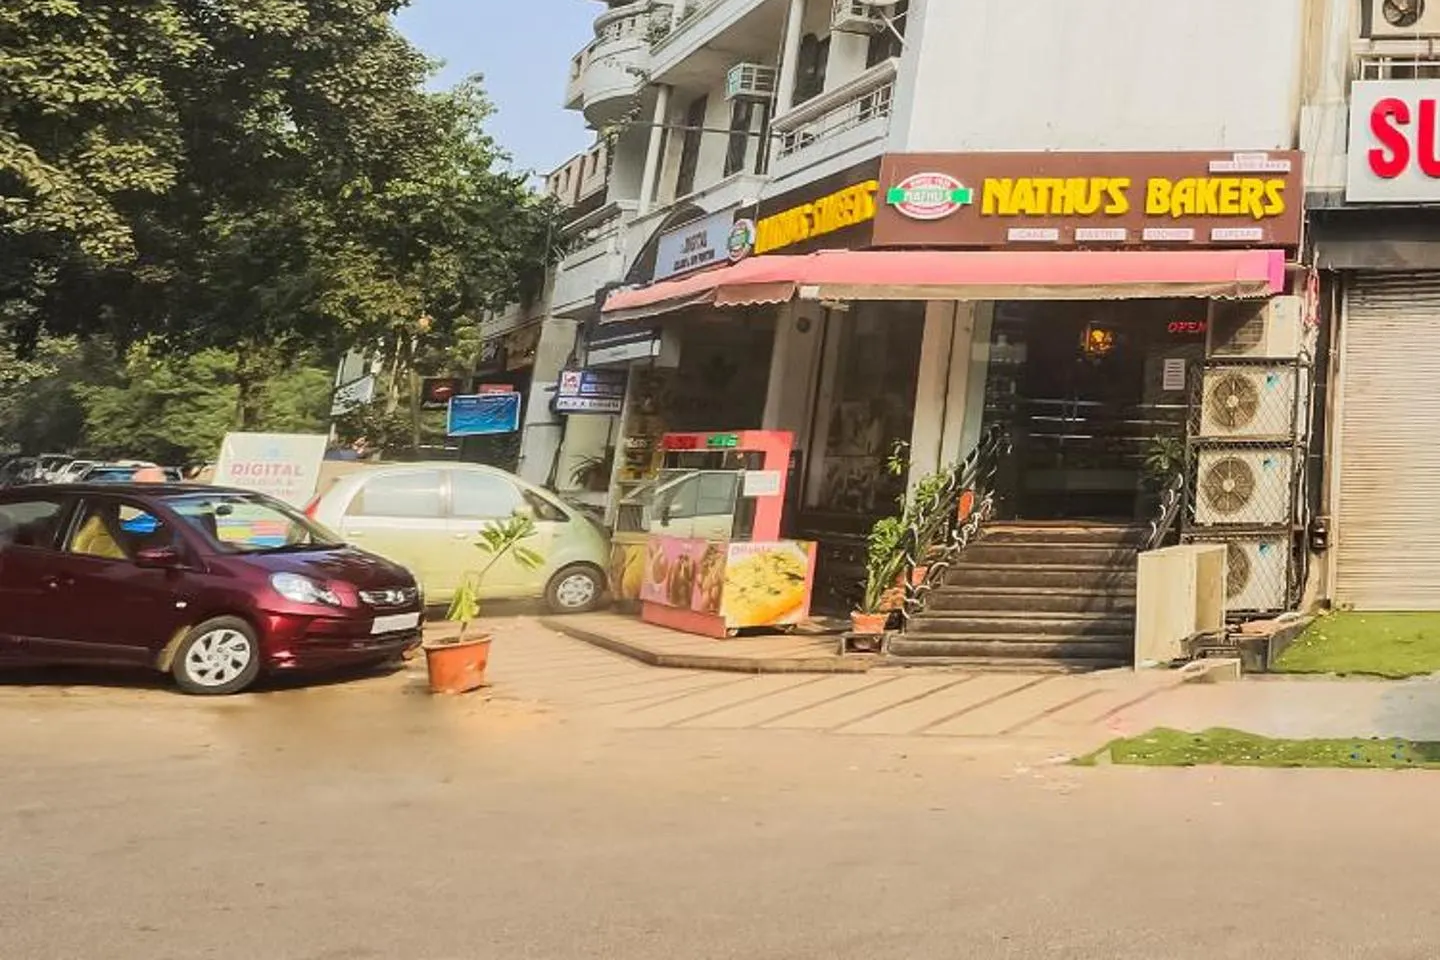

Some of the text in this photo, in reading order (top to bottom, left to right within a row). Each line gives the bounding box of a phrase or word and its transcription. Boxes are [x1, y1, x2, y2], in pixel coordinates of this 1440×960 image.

[981, 177, 1286, 219] NATHU'S BAKERS
[230, 462, 305, 477] DIGITAL
